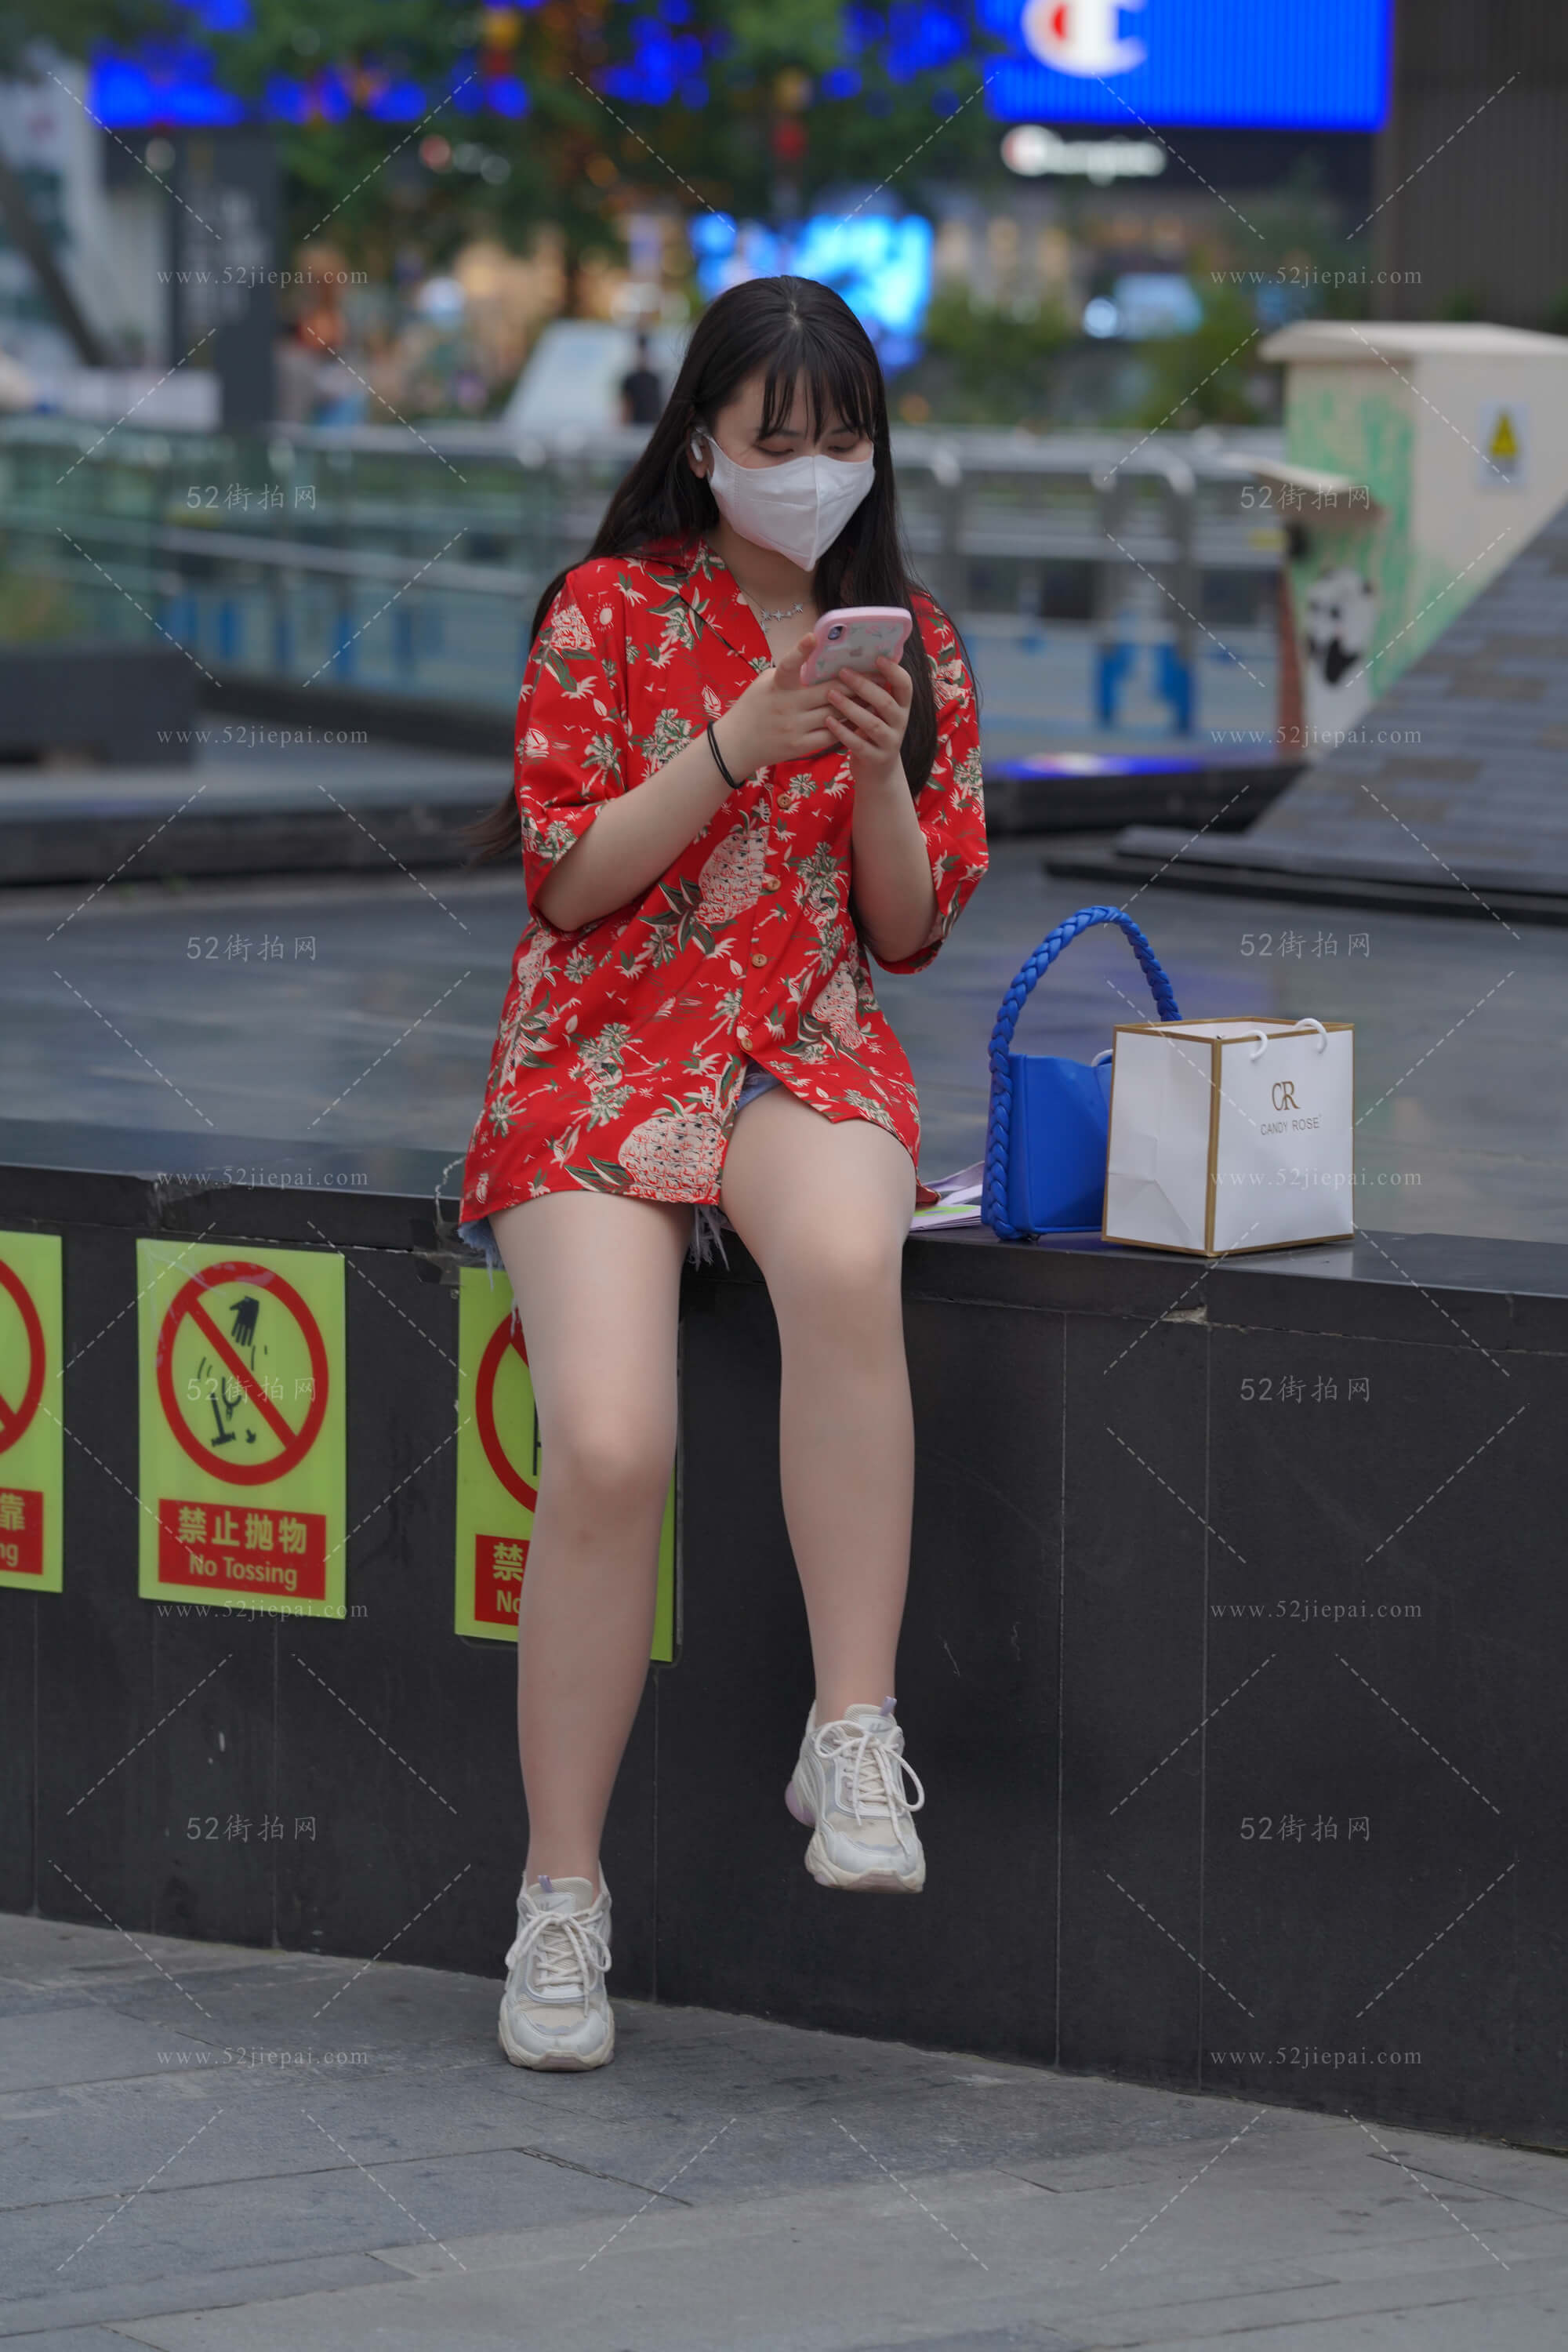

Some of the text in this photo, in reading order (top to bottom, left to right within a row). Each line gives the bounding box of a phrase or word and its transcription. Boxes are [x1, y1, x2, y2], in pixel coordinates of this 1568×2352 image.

[1272, 1080, 1301, 1111] CR
[1260, 1117, 1320, 1135] CANDY ROSE
[177, 1505, 307, 1555] 禁止抛物
[189, 1553, 297, 1592] No Tossing
[493, 1541, 524, 1583] 禁
